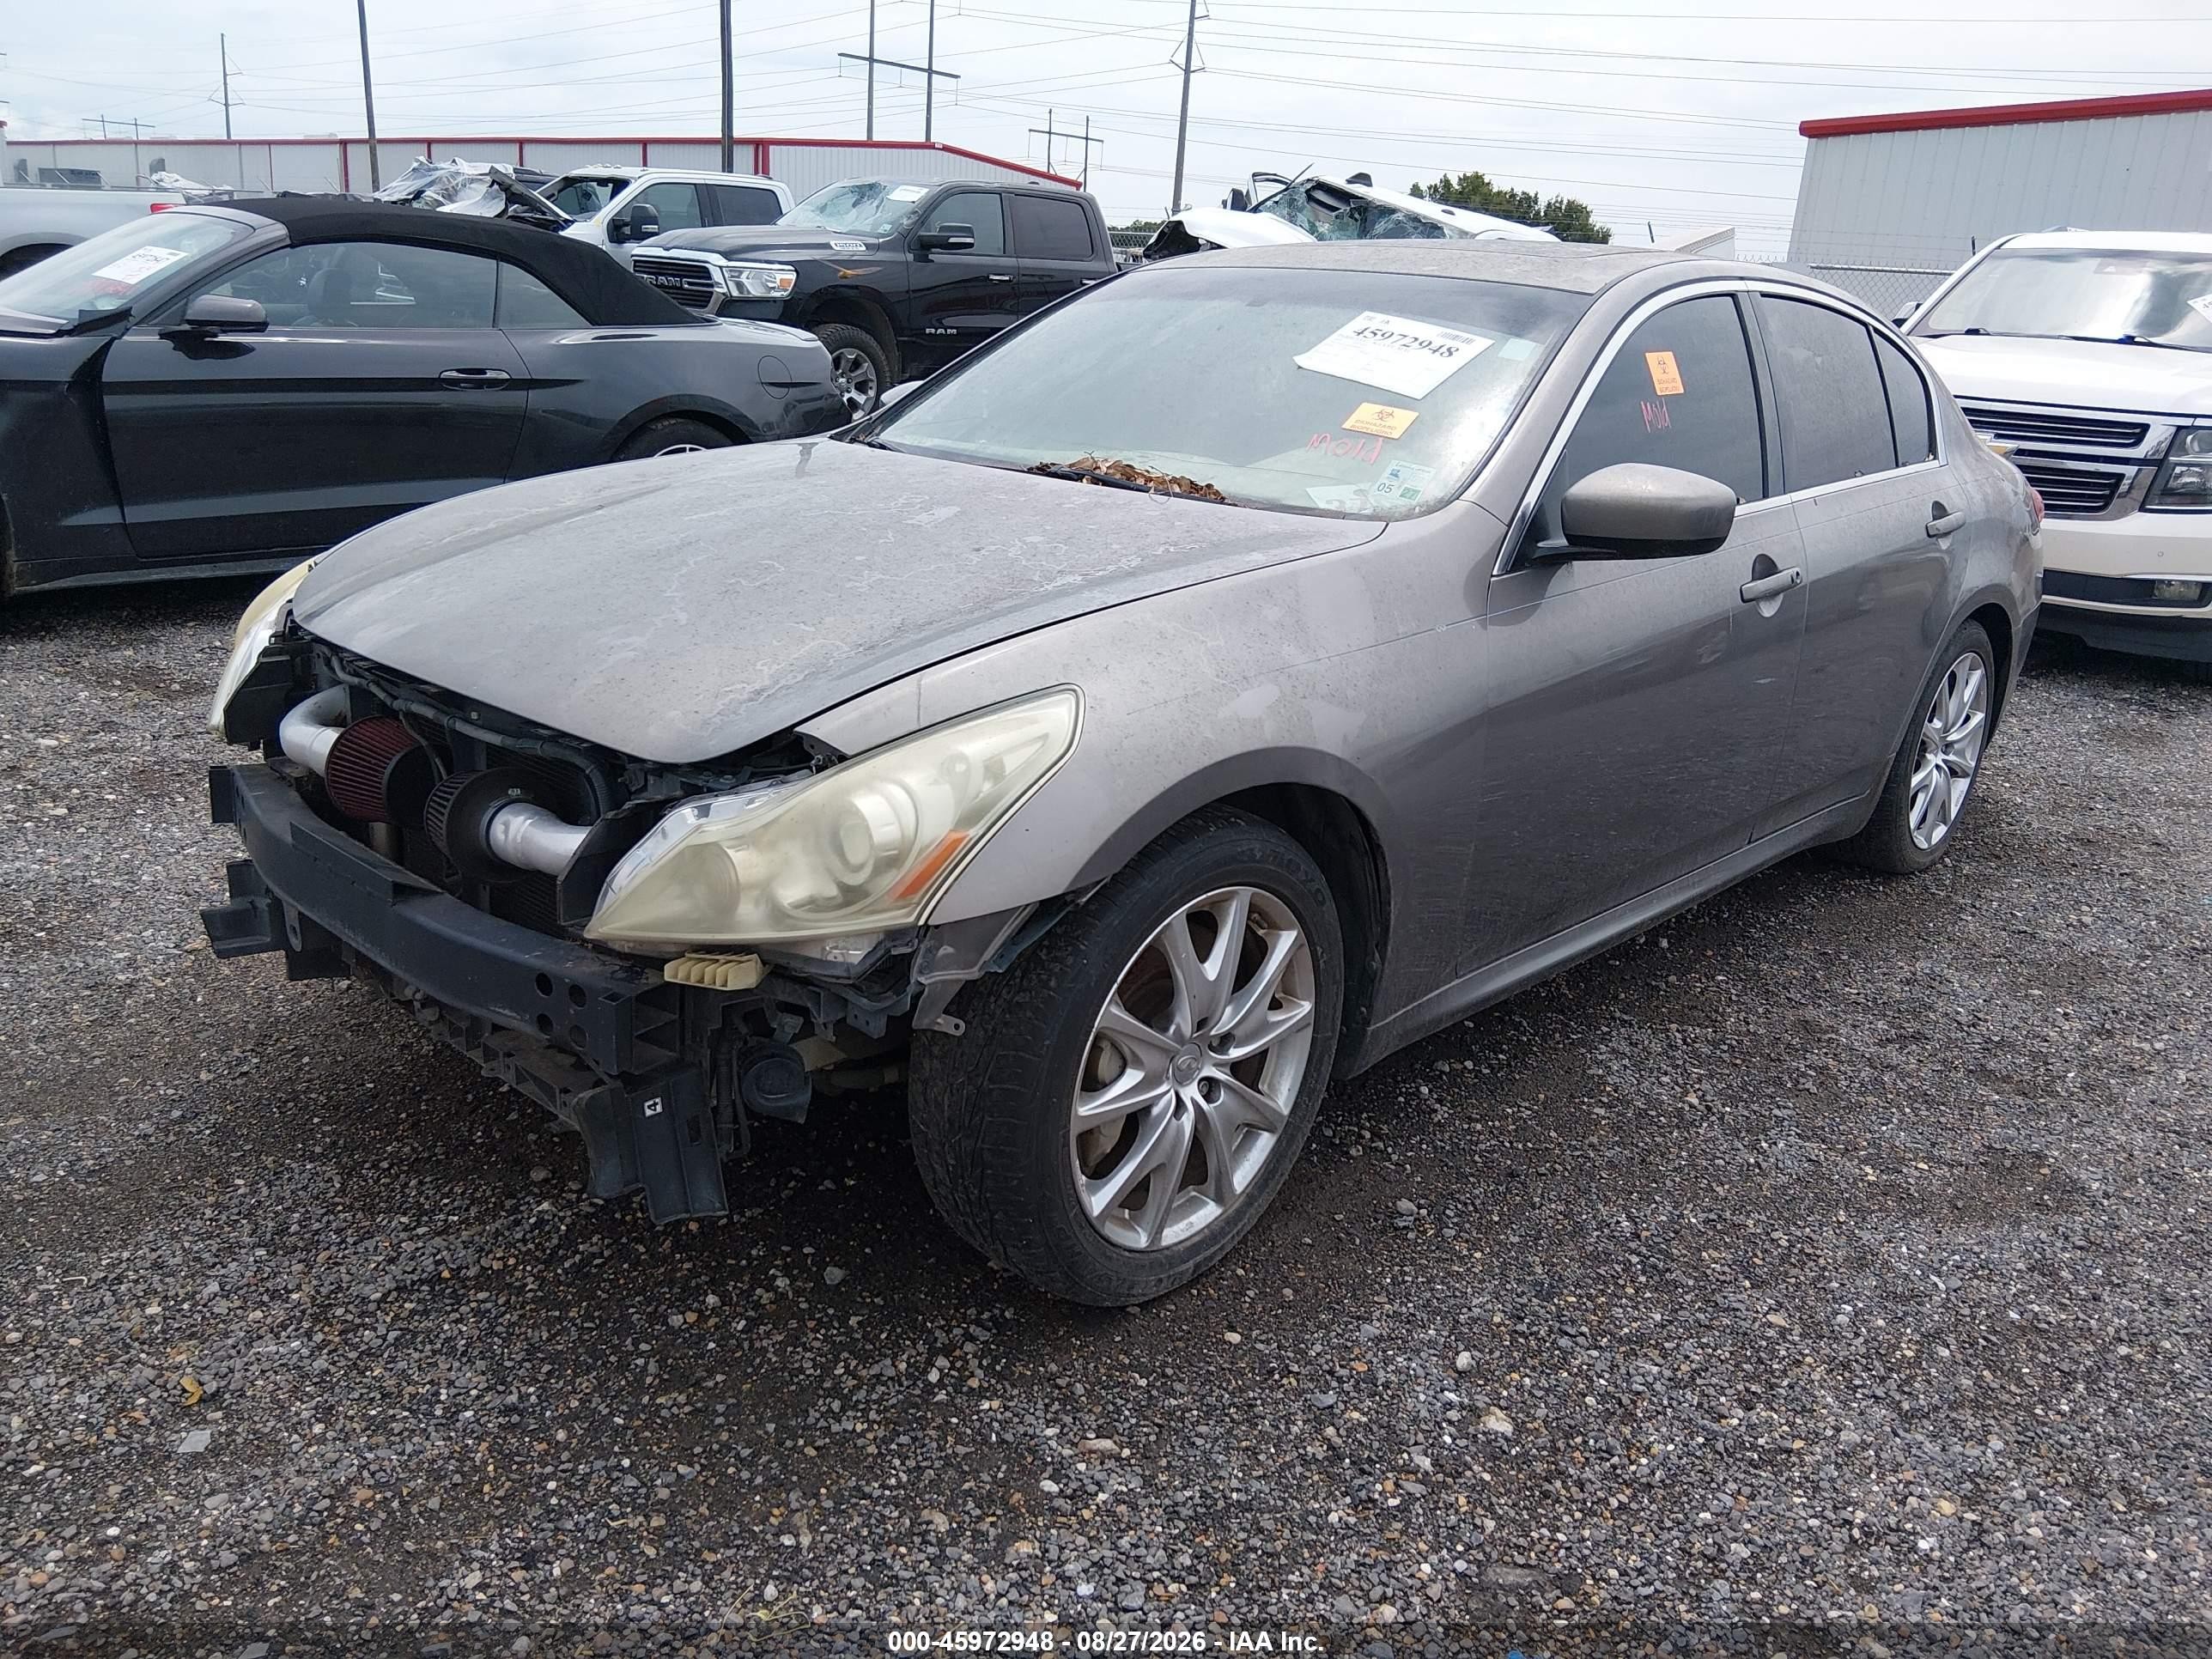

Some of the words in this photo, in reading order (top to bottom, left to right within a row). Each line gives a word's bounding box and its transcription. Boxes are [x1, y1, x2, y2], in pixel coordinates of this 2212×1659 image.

[645, 275, 681, 288] RAM
[1352, 326, 1460, 358] 45972948
[1354, 419, 1397, 430] BIOHAZARD
[1376, 483, 1395, 494] 05
[647, 1100, 659, 1112] 4
